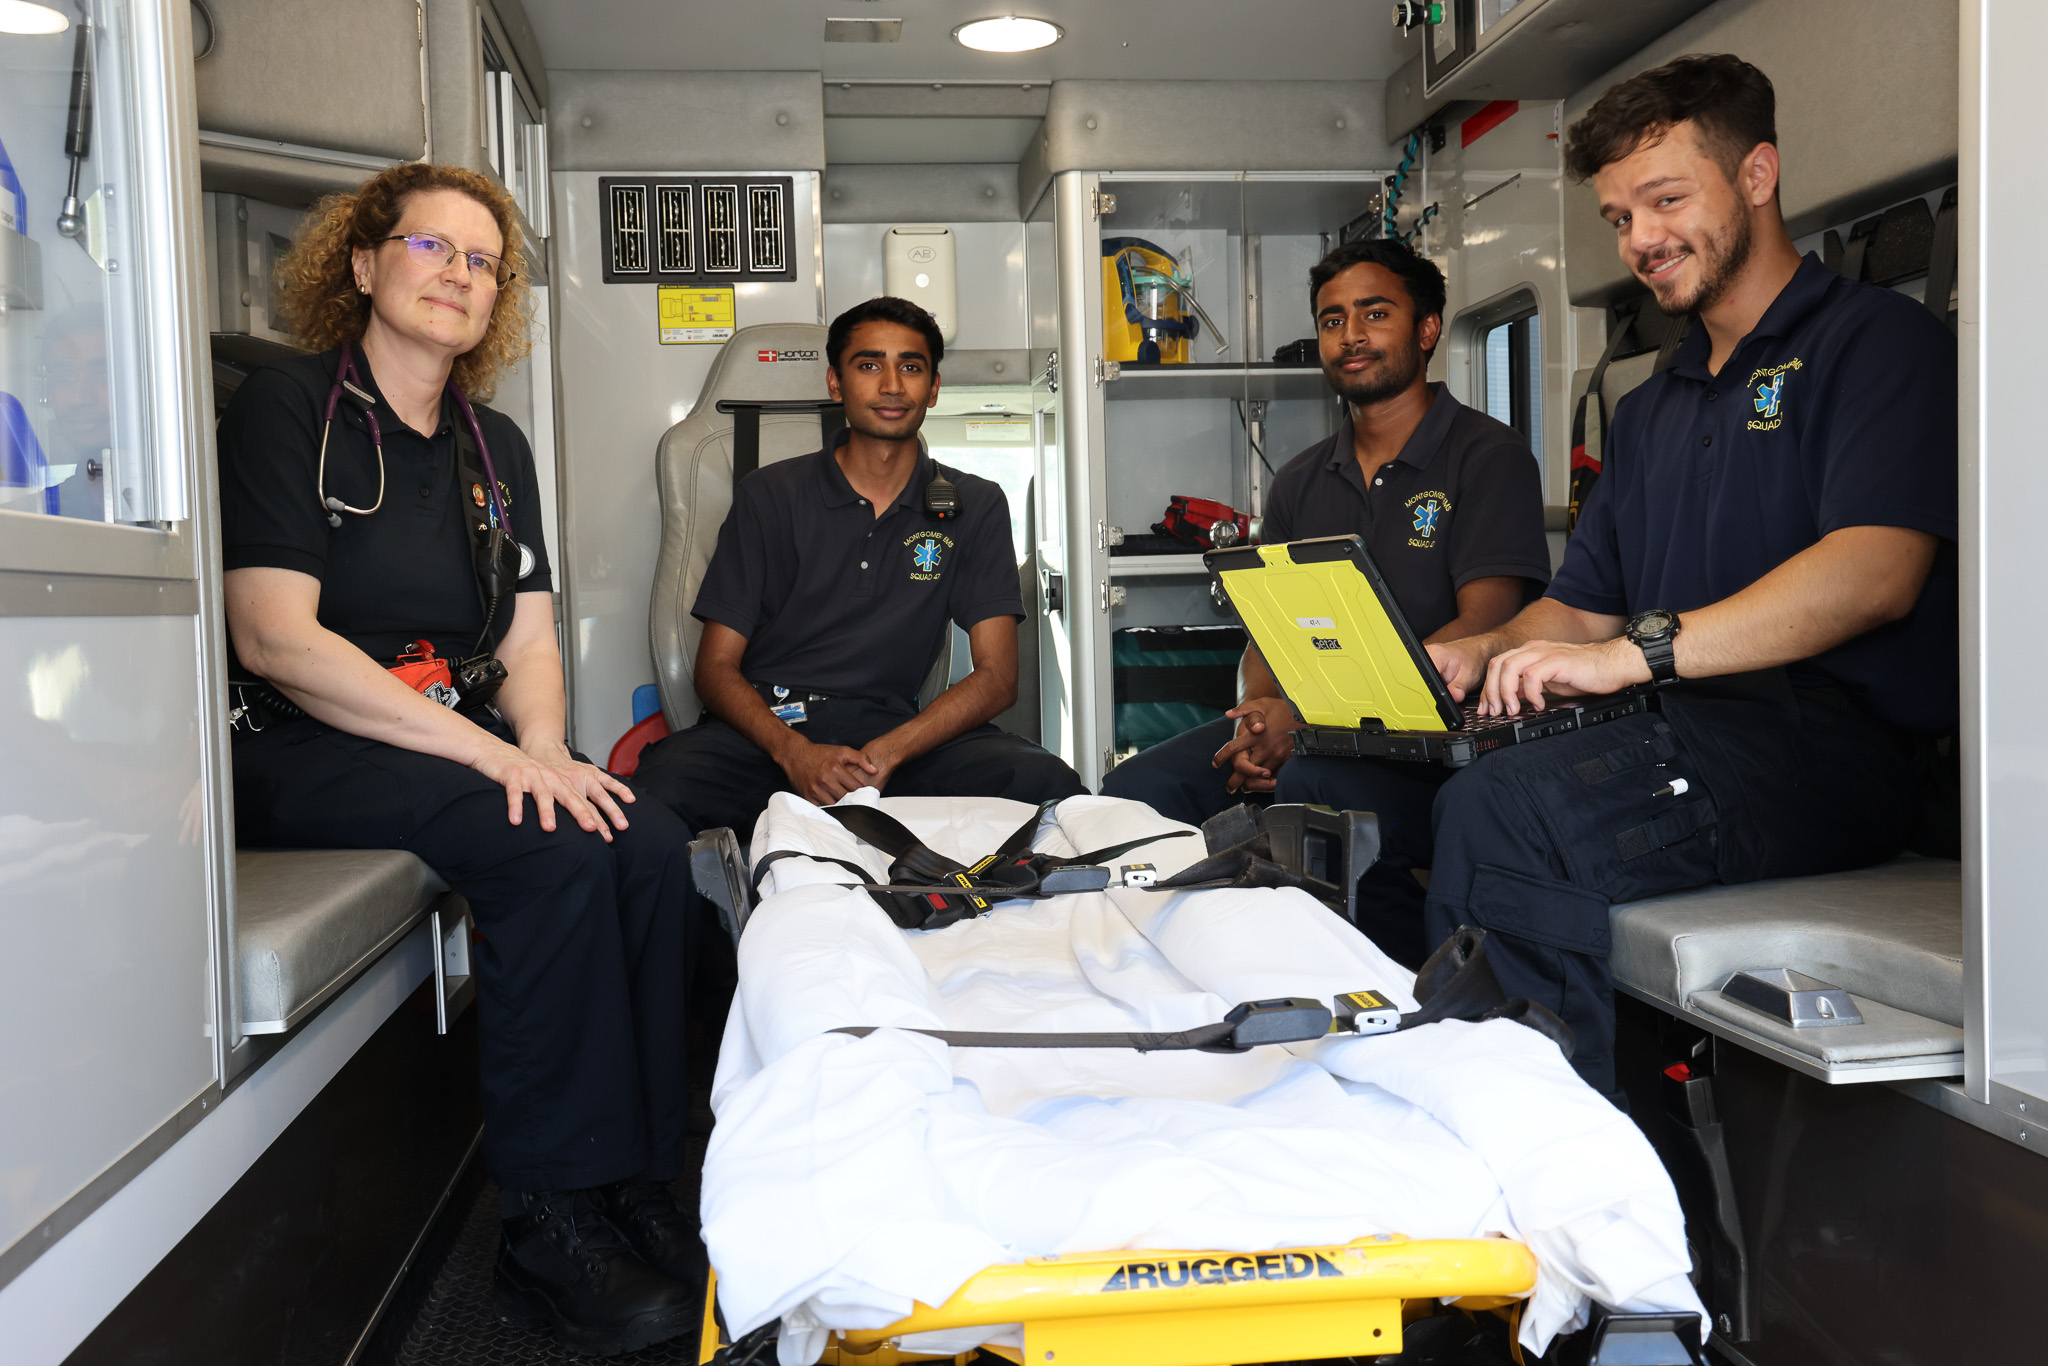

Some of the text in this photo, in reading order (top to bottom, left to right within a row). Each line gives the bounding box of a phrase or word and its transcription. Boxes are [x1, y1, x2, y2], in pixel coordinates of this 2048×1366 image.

[777, 349, 819, 358] Horton
[1747, 418, 1782, 431] SQUAD
[942, 536, 954, 548] EMS
[1407, 538, 1430, 548] SQUAD
[910, 572, 933, 581] SQUAD
[1311, 635, 1342, 650] Getac
[1127, 1253, 1315, 1289] RUGGED
